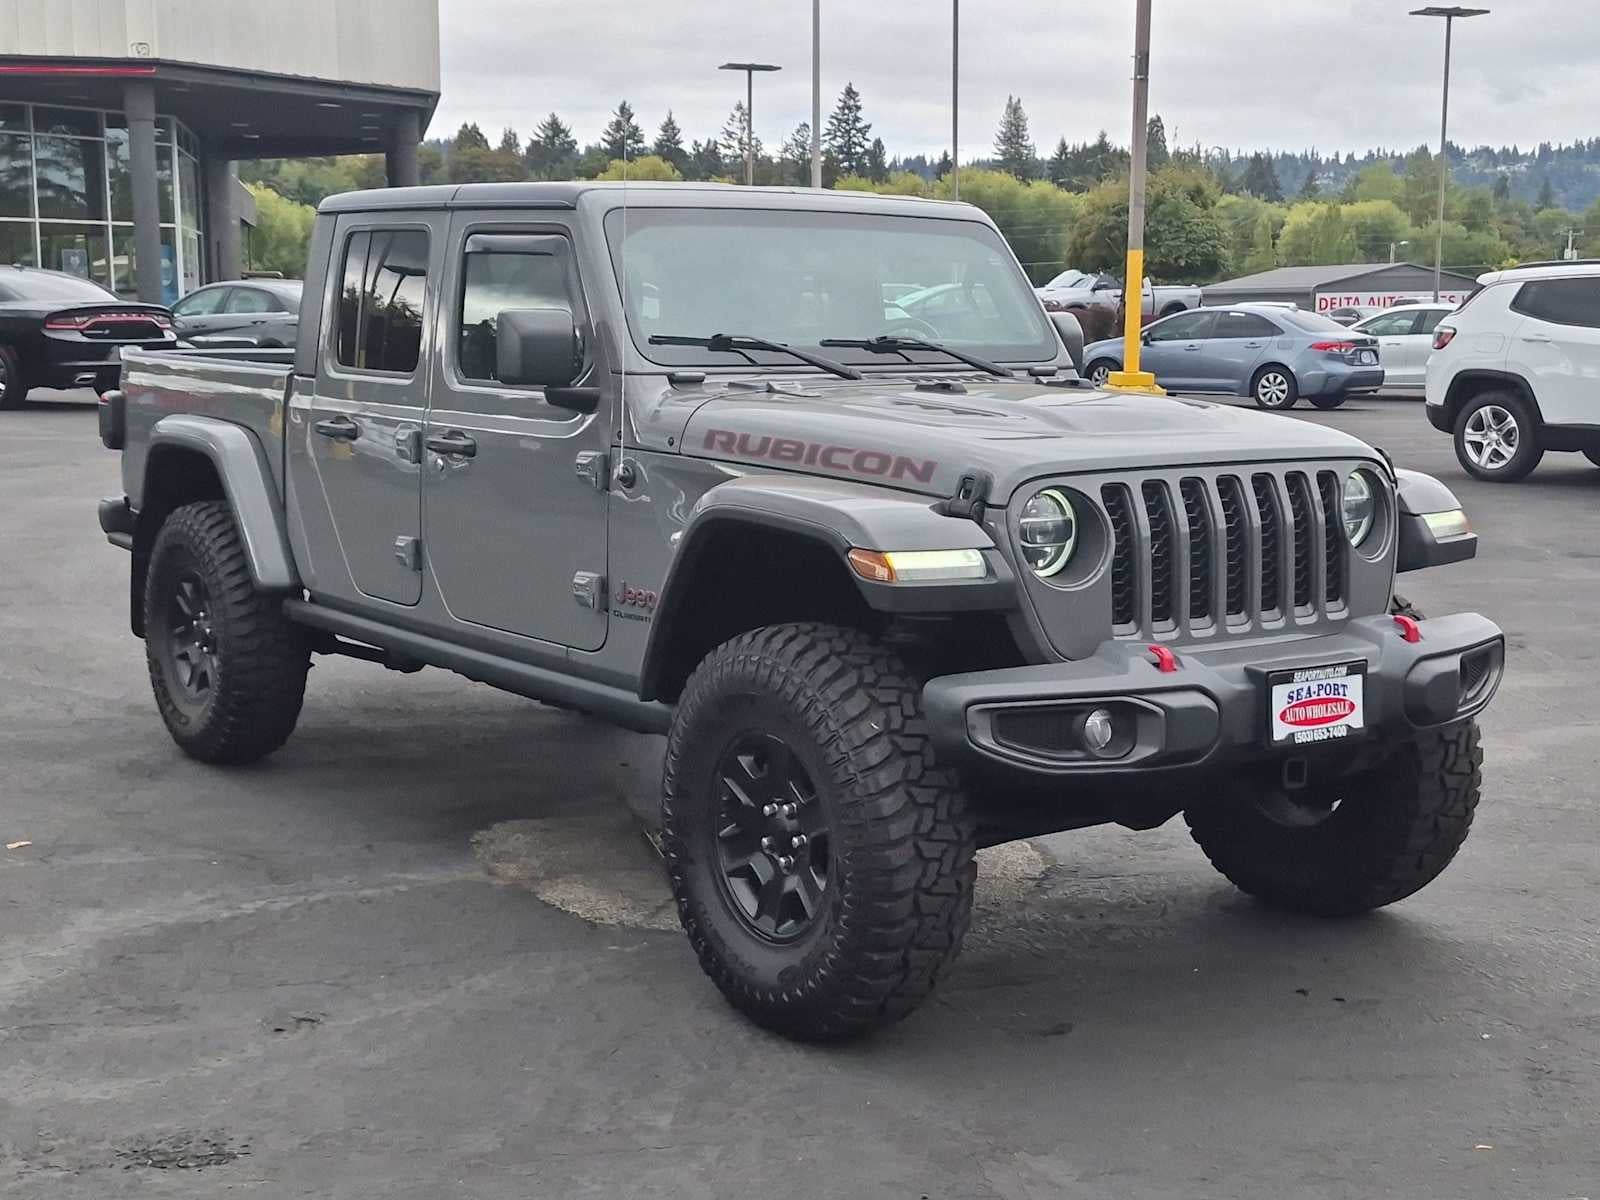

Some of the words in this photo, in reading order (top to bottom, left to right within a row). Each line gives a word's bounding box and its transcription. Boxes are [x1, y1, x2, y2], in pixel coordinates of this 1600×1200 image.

[702, 428, 938, 484] RUBICON
[615, 579, 657, 610] Jeep
[1294, 667, 1347, 682] SEAPORTAUTO.COM
[1287, 683, 1348, 704] SEA-PORT
[1285, 707, 1305, 722] AUTO
[1306, 702, 1351, 719] WHOLESALE
[1295, 731, 1313, 744] (503)
